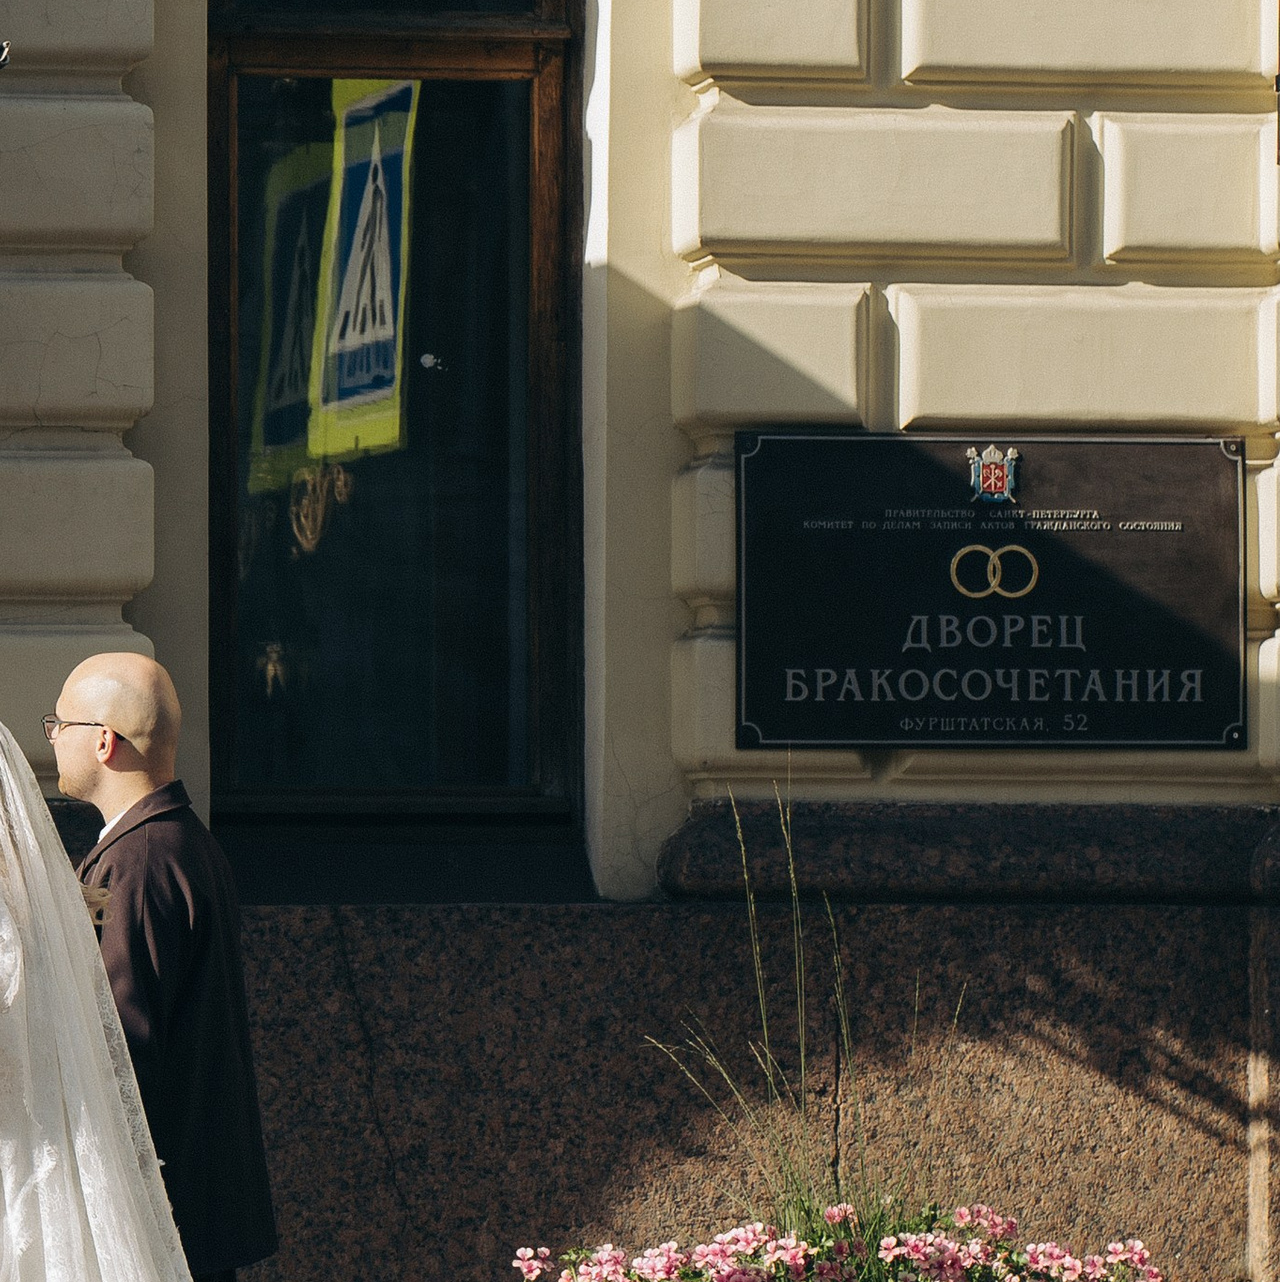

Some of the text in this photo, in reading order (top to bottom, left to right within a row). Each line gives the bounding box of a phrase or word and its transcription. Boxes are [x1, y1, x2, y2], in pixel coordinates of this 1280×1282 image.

[884, 509, 1100, 519] ПРАВИТЕЛЬСТВО САНКТ-ПЕТЕРБУРГА
[802, 520, 1183, 531] КОМИТЕТ ПО ДЕЛАМ ЗАПИСИ АКТОВ ГРАЖДАНСКОГО СОСТОЯНИЯ
[901, 615, 1087, 653] ДВОРЕЦ
[784, 668, 1204, 703] БРАКОСОЧЕТАНИЯ
[1063, 714, 1089, 731] 52
